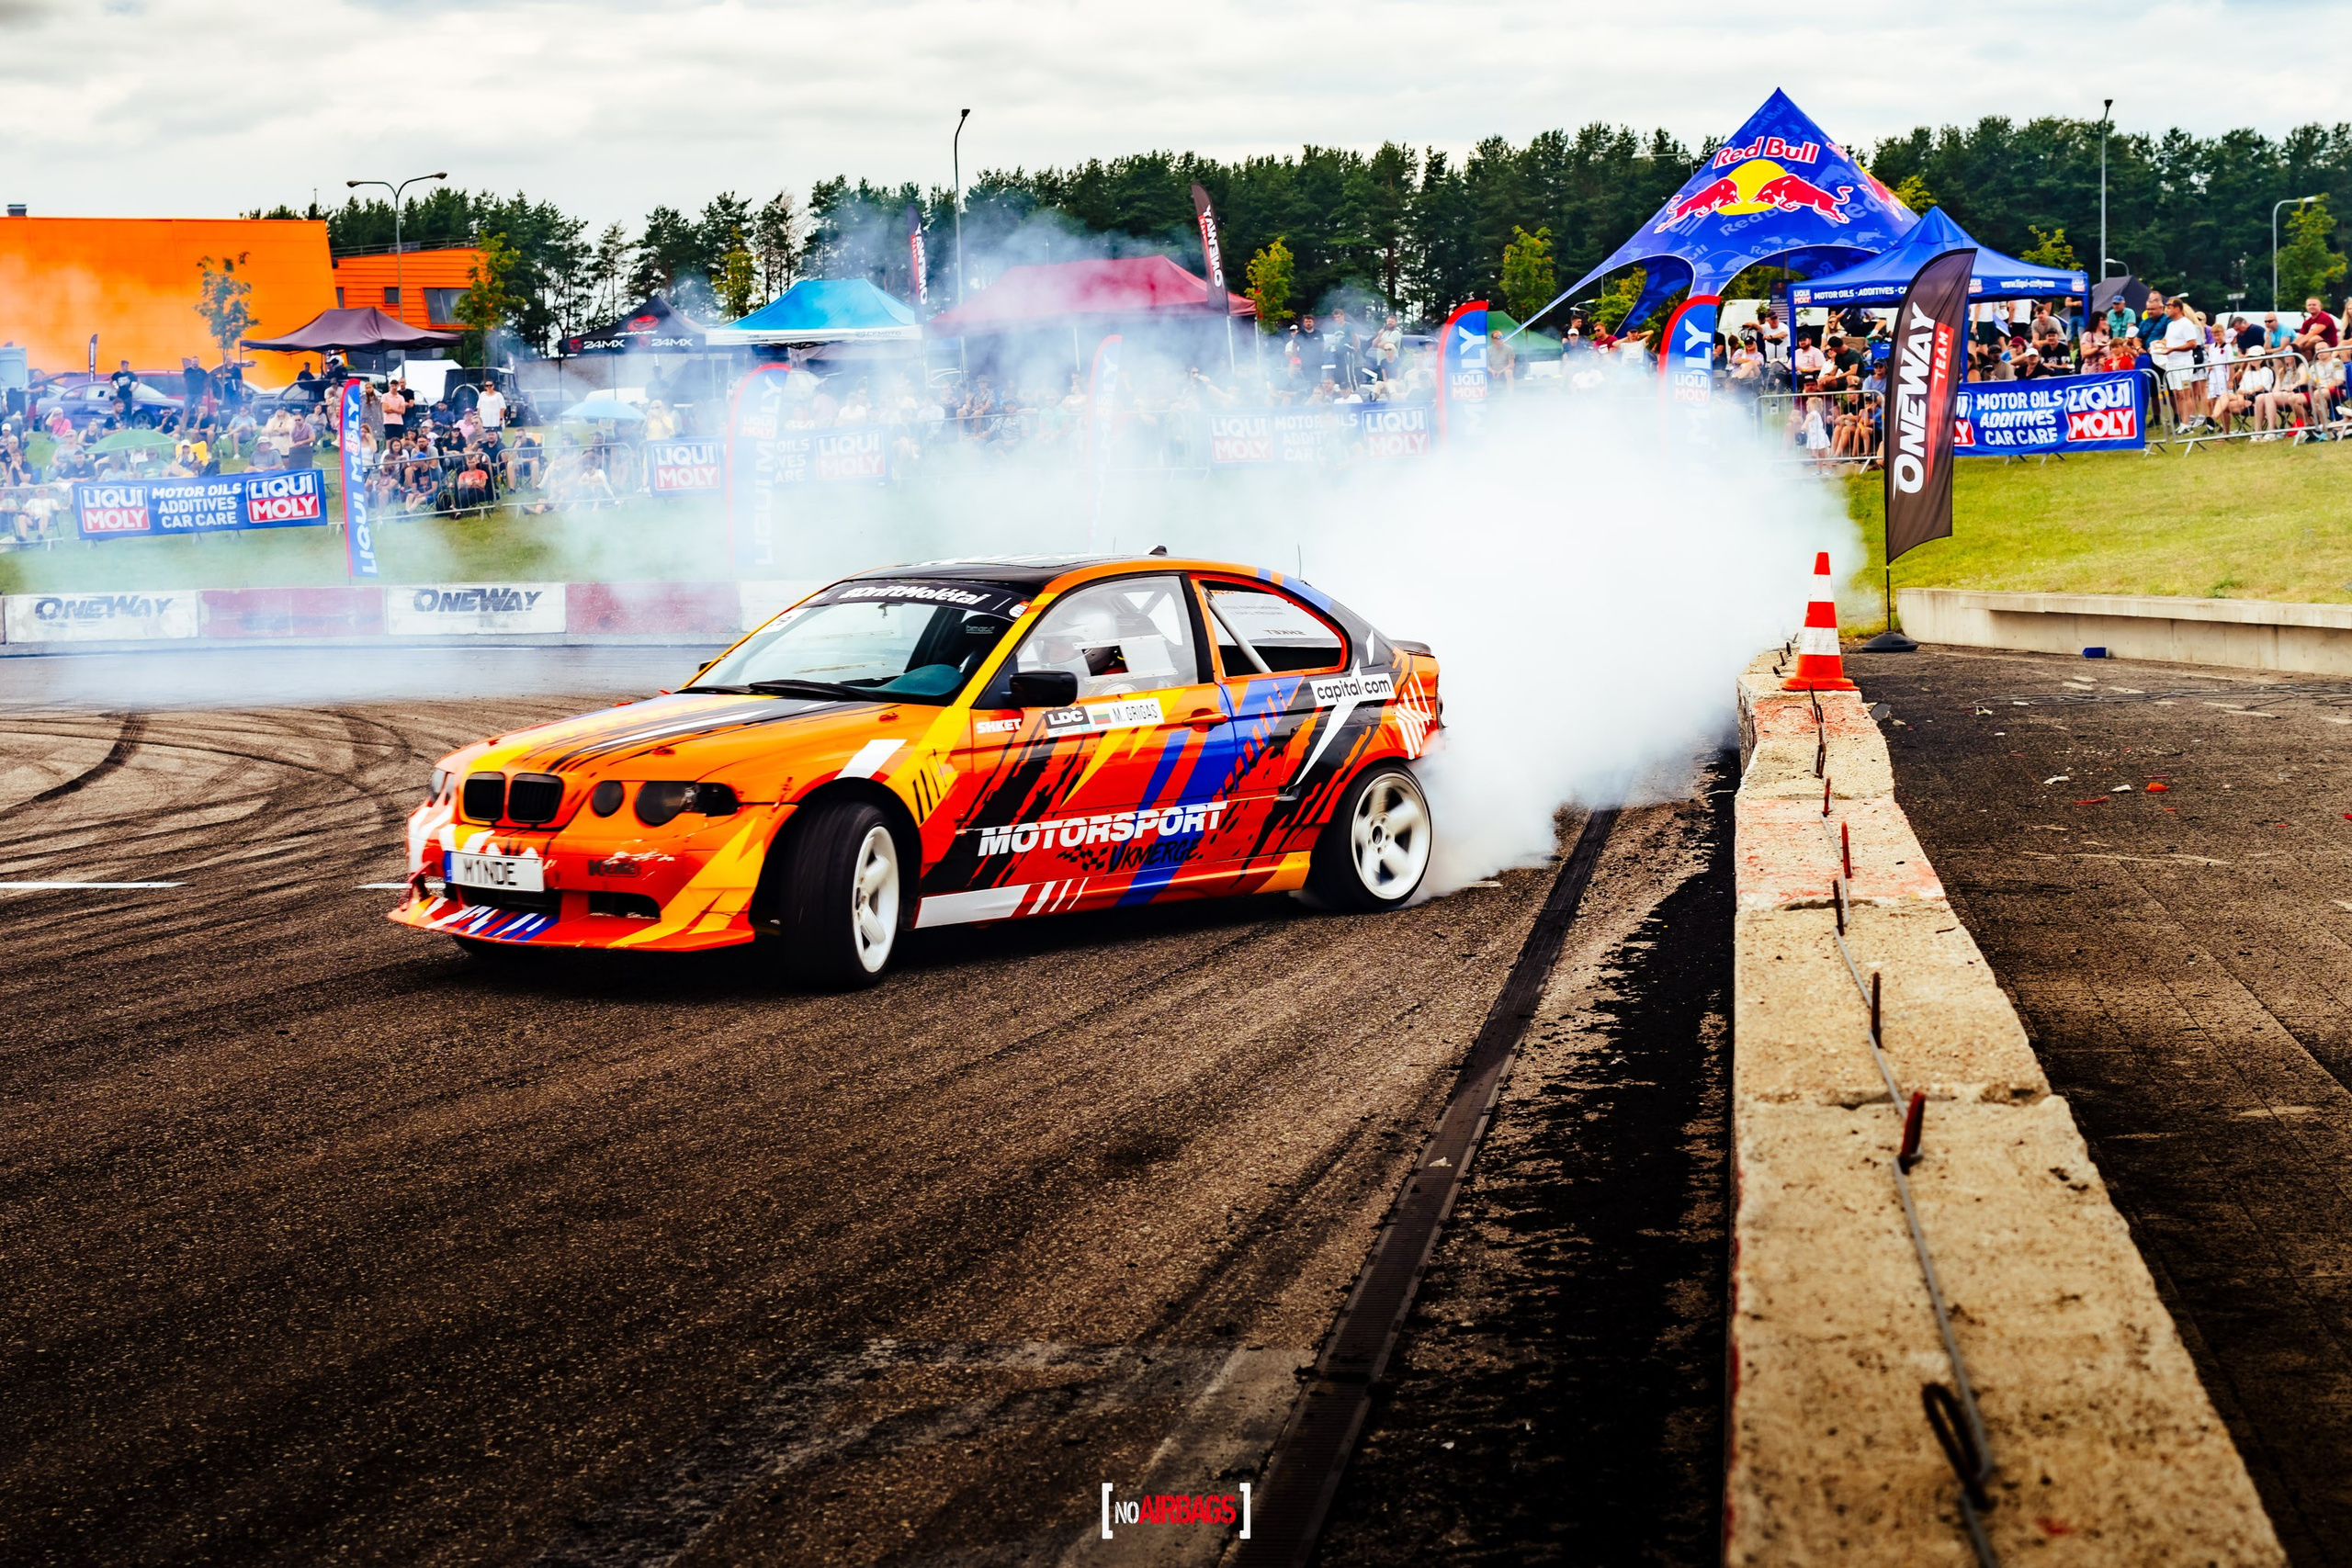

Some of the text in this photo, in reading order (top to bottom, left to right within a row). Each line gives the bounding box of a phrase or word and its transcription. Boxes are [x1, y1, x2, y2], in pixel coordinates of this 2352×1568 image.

[1712, 136, 1765, 169] Red
[1763, 137, 1820, 164] Bull
[1814, 291, 1838, 300] MOTOR
[1838, 289, 1855, 298] OILS
[1858, 287, 1894, 297] ADDITIVES
[583, 339, 626, 350] 24MX
[650, 337, 694, 347] 24MX
[1934, 331, 1949, 384] TEAM
[1452, 374, 1485, 386] LIQUI
[1674, 374, 1708, 387] LIQUI
[1453, 386, 1486, 398] MOLY
[1675, 389, 1709, 400] MOLY
[1893, 301, 1936, 501] ONEWAY
[1976, 391, 2029, 411] MOTOR
[2030, 389, 2064, 408] OILS
[2068, 382, 2131, 412] LIQUI
[1211, 416, 1268, 438] LIQUI
[1366, 411, 1425, 433] LIQUI
[1979, 409, 2056, 428] ADDITIVES
[2069, 410, 2133, 439] MOLY
[776, 438, 809, 453] OILS
[819, 433, 880, 456] LIQUI
[1368, 434, 1427, 457] MOLY
[1984, 430, 2015, 446] CAR
[2015, 427, 2058, 445] CARE
[655, 445, 716, 468] LIQUI
[1214, 439, 1272, 459] MOLY
[774, 468, 807, 484] ARE
[820, 454, 883, 478] MOLY
[249, 474, 313, 499] LIQUI
[658, 467, 718, 488] MOLY
[82, 489, 144, 510] LIQUI
[152, 482, 243, 500] MOTOR OILS
[157, 496, 238, 514] ADDITIVES
[251, 496, 317, 521] MOLY
[85, 508, 148, 530] MOLY
[162, 512, 238, 528] CAR CARE
[353, 492, 379, 573] LIQUI
[1113, 704, 1159, 722] M. GRIGAS
[976, 717, 1023, 734] SHKET
[978, 802, 1228, 856] MOTORSPORT
